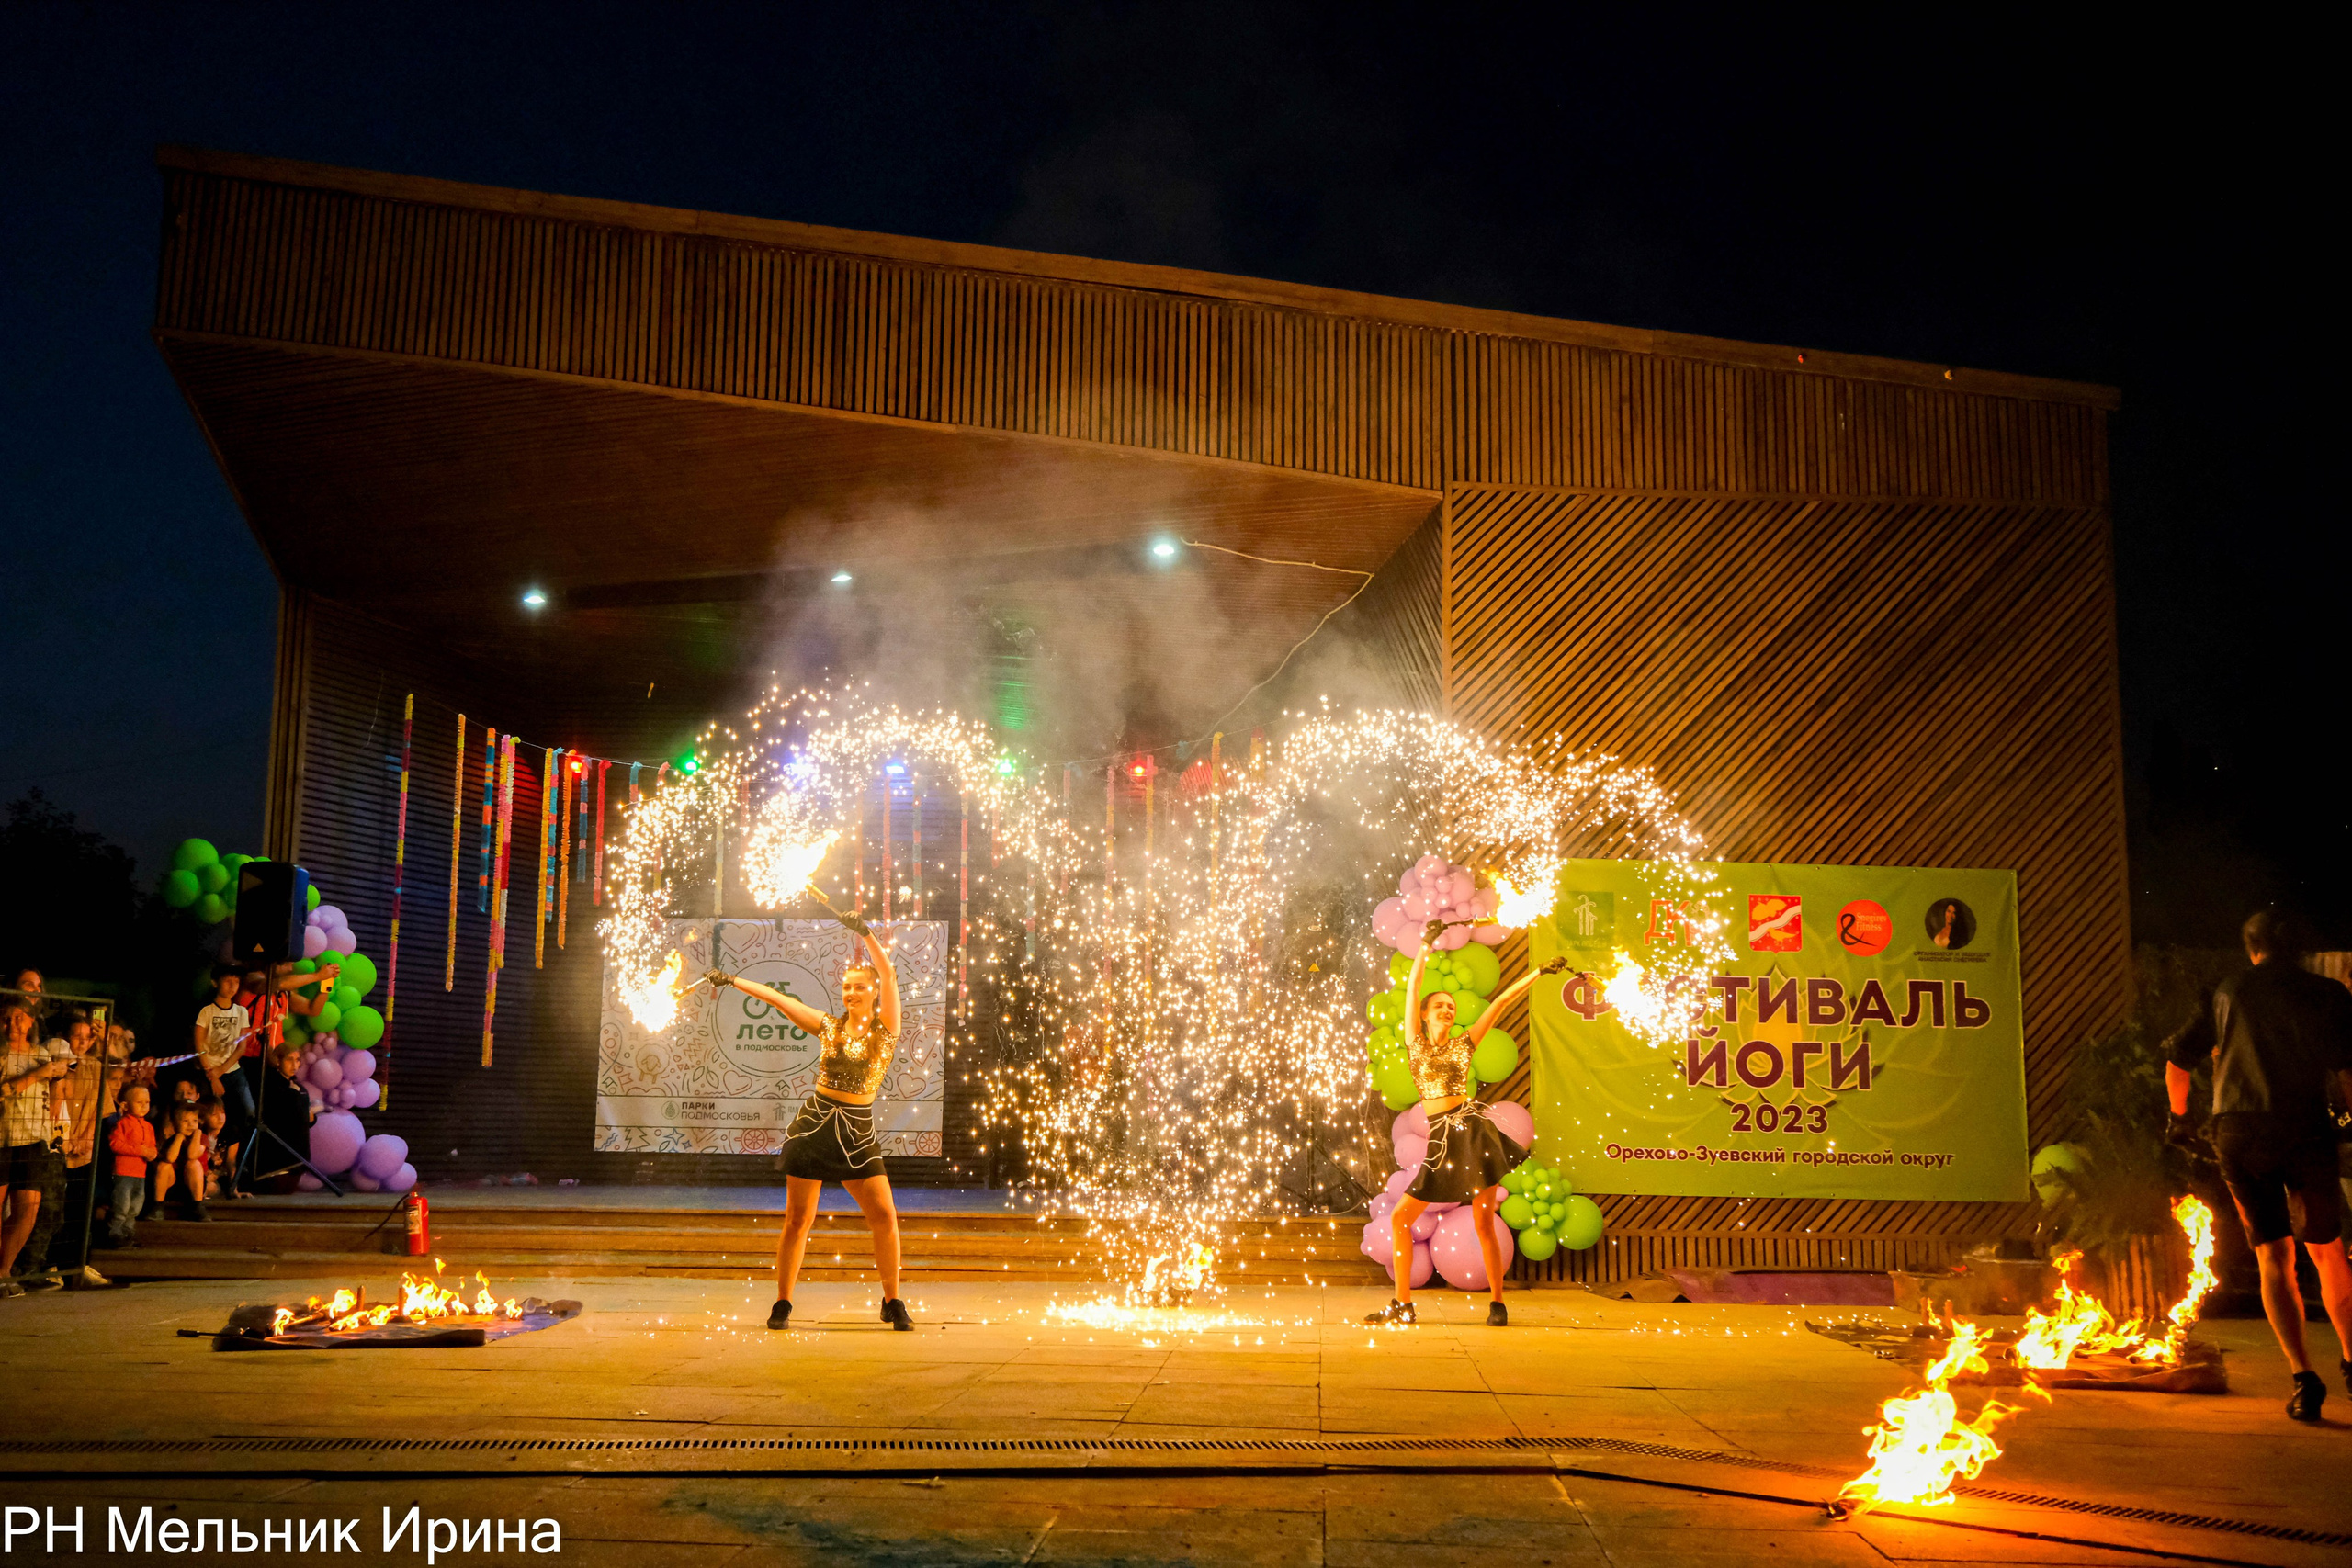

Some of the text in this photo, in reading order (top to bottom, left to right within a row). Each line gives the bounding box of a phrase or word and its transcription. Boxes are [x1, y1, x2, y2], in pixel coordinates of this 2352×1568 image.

[1561, 971, 1992, 1030] ФСТИВАЛЬ
[736, 1023, 808, 1041] лето
[743, 1043, 808, 1053] ПОДМОСКОВЬЕ
[1686, 1025, 1872, 1091] ЙОГИ
[681, 1101, 716, 1111] ПАРКИ
[681, 1111, 761, 1121] ПОДМОСКОВЬЯ
[1729, 1102, 1829, 1135] 2023
[1605, 1143, 1955, 1170] Орехово-Зуевский городской округ
